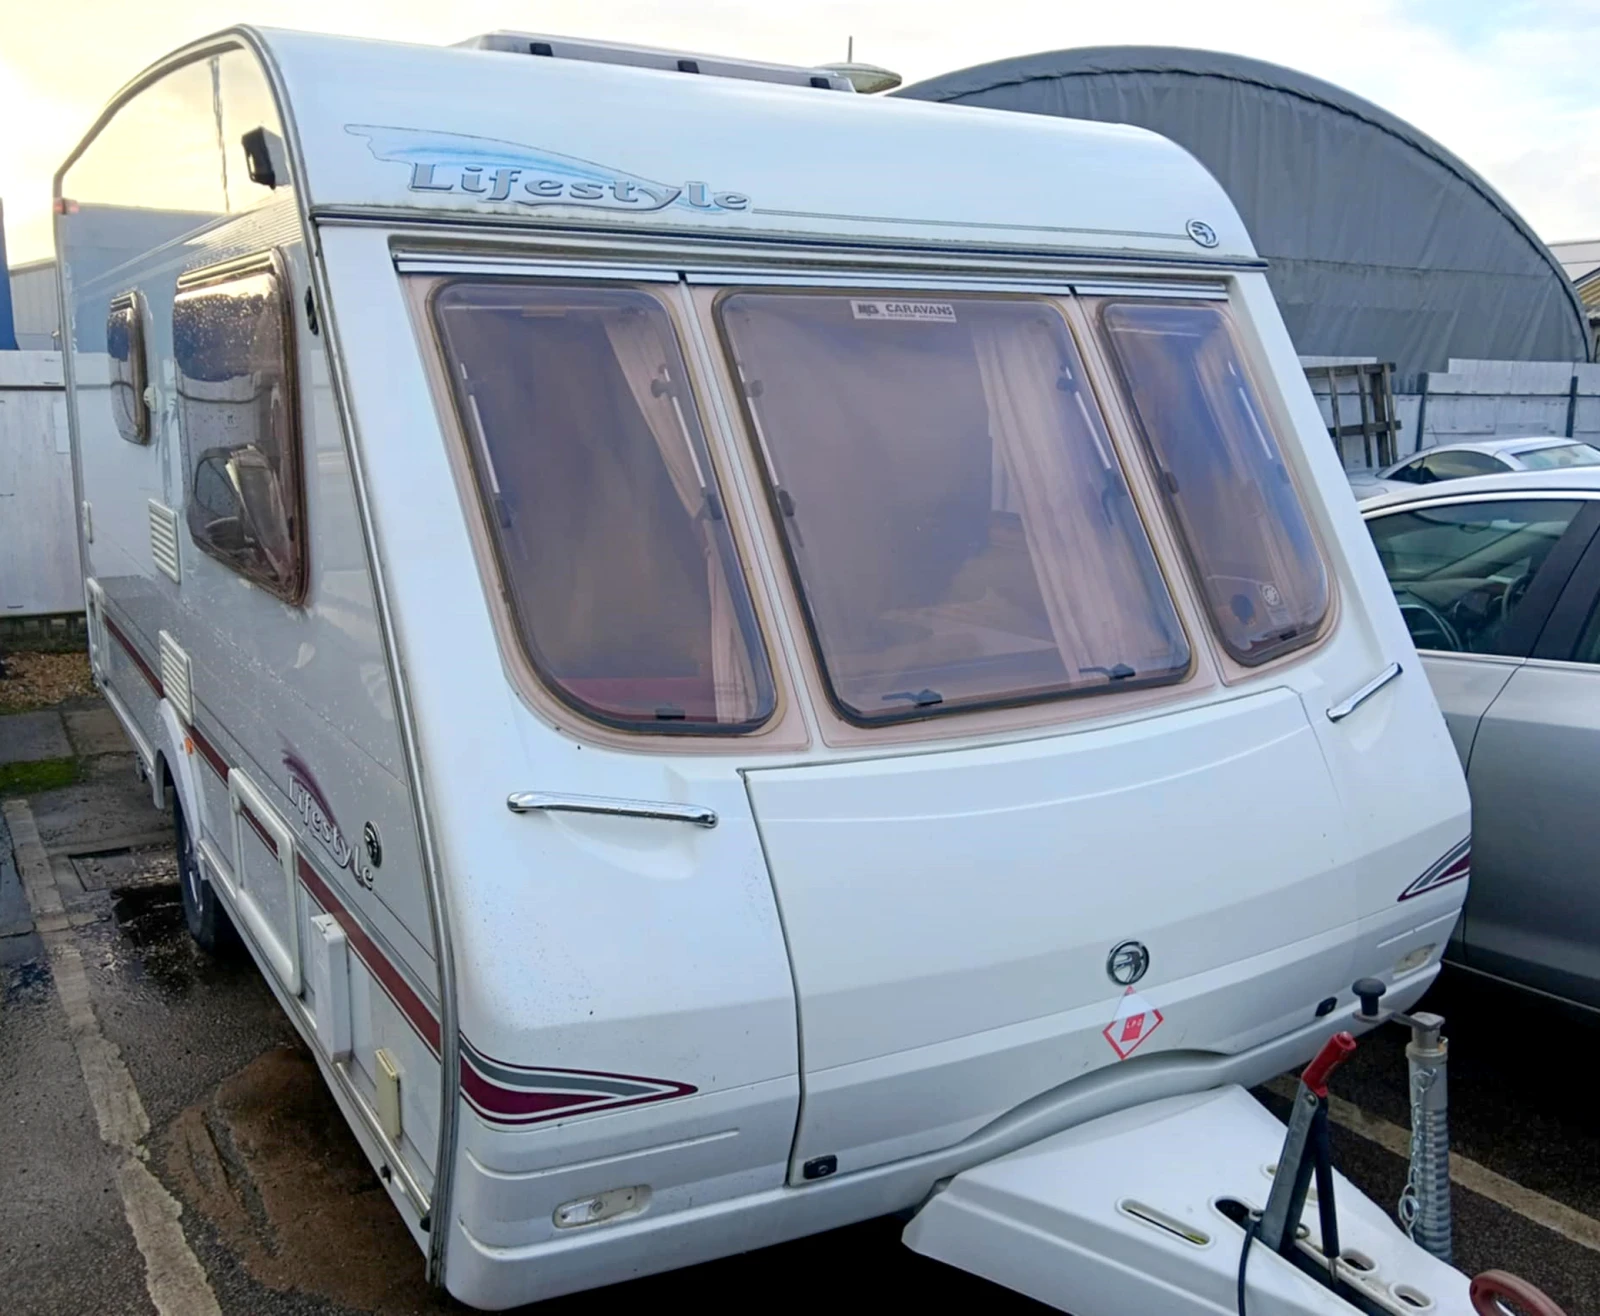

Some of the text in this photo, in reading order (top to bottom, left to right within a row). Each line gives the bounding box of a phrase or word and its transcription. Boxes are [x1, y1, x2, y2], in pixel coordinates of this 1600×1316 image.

[410, 162, 750, 212] Lifestyle
[885, 304, 953, 316] CARAVANS
[288, 775, 374, 891] Lifestyle
